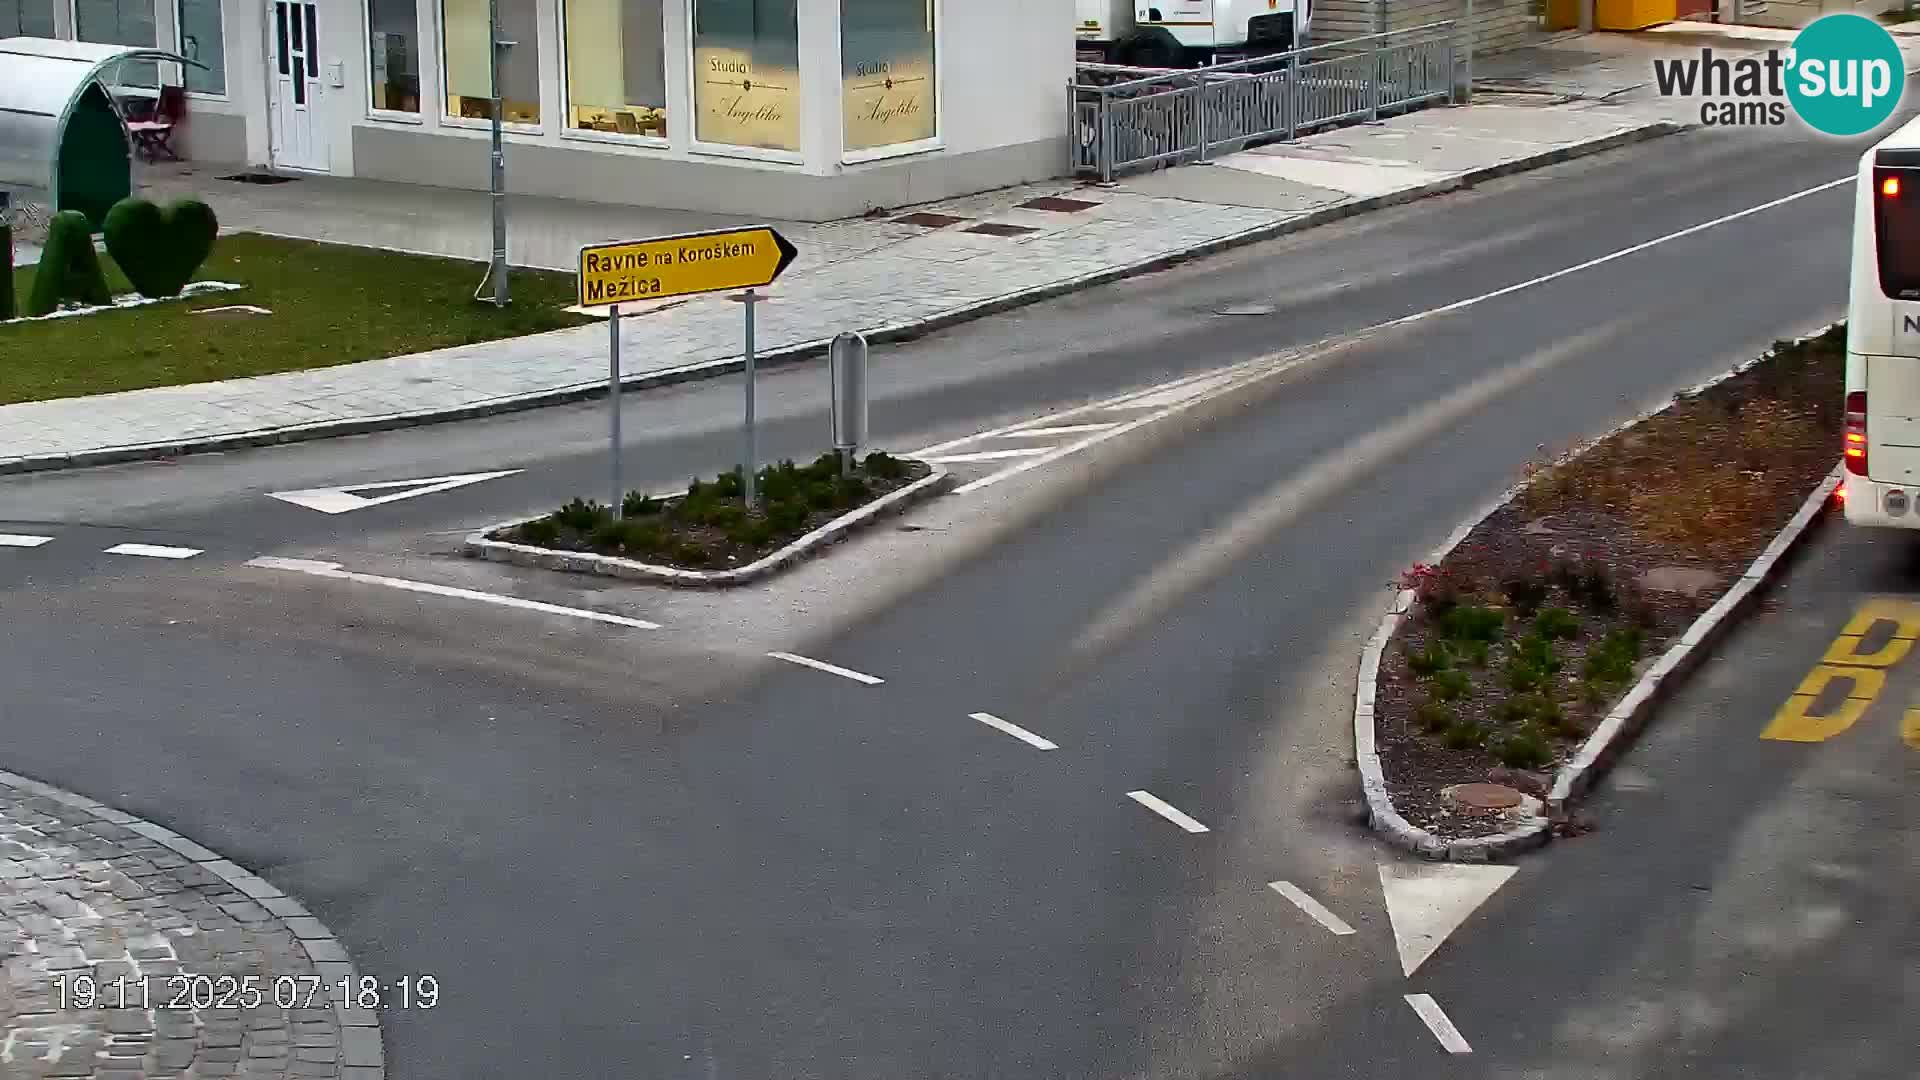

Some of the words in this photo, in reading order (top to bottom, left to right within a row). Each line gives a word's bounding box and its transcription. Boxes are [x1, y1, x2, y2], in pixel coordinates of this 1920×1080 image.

[709, 58, 747, 74] Studio
[856, 61, 888, 77] Studio
[712, 95, 782, 125] Angelika
[858, 95, 920, 125] Angelika
[586, 252, 649, 273] Ravne
[654, 252, 674, 265] na
[678, 241, 755, 264] Koroškem
[587, 276, 661, 300] Mežica
